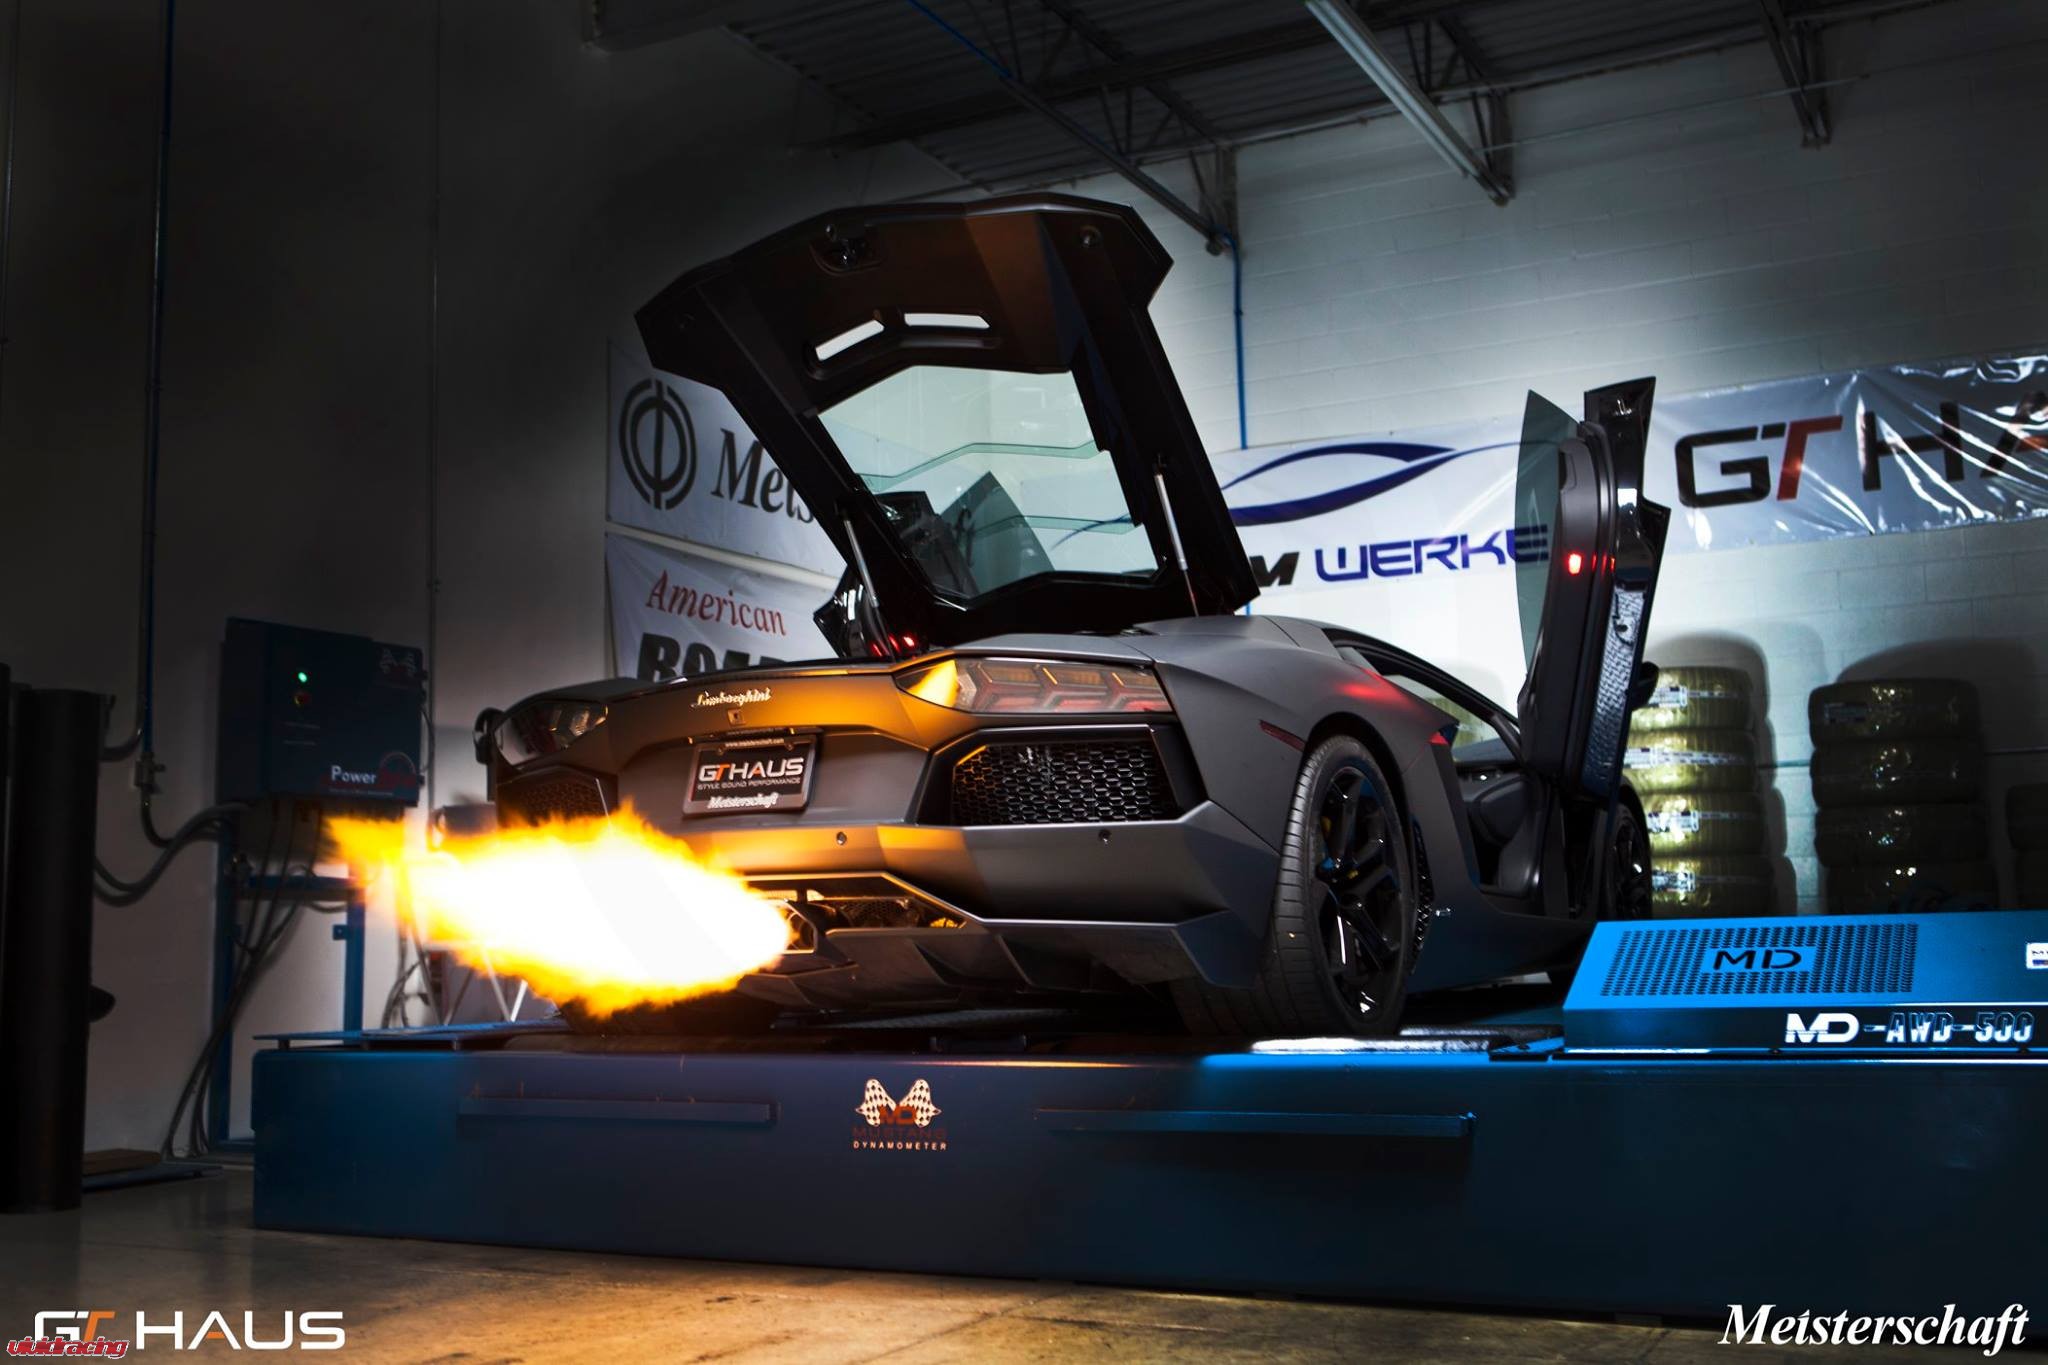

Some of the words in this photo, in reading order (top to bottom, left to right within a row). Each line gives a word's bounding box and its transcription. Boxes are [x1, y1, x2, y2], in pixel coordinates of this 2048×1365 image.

[1675, 415, 1843, 508] GT
[1315, 524, 1549, 582] WERKE
[645, 569, 787, 636] American
[331, 764, 377, 784] Power
[697, 782, 720, 790] STYLE
[748, 777, 801, 787] PERFORMANCE
[1711, 949, 1803, 971] MD
[852, 1140, 948, 1151] DYNAMOMETER
